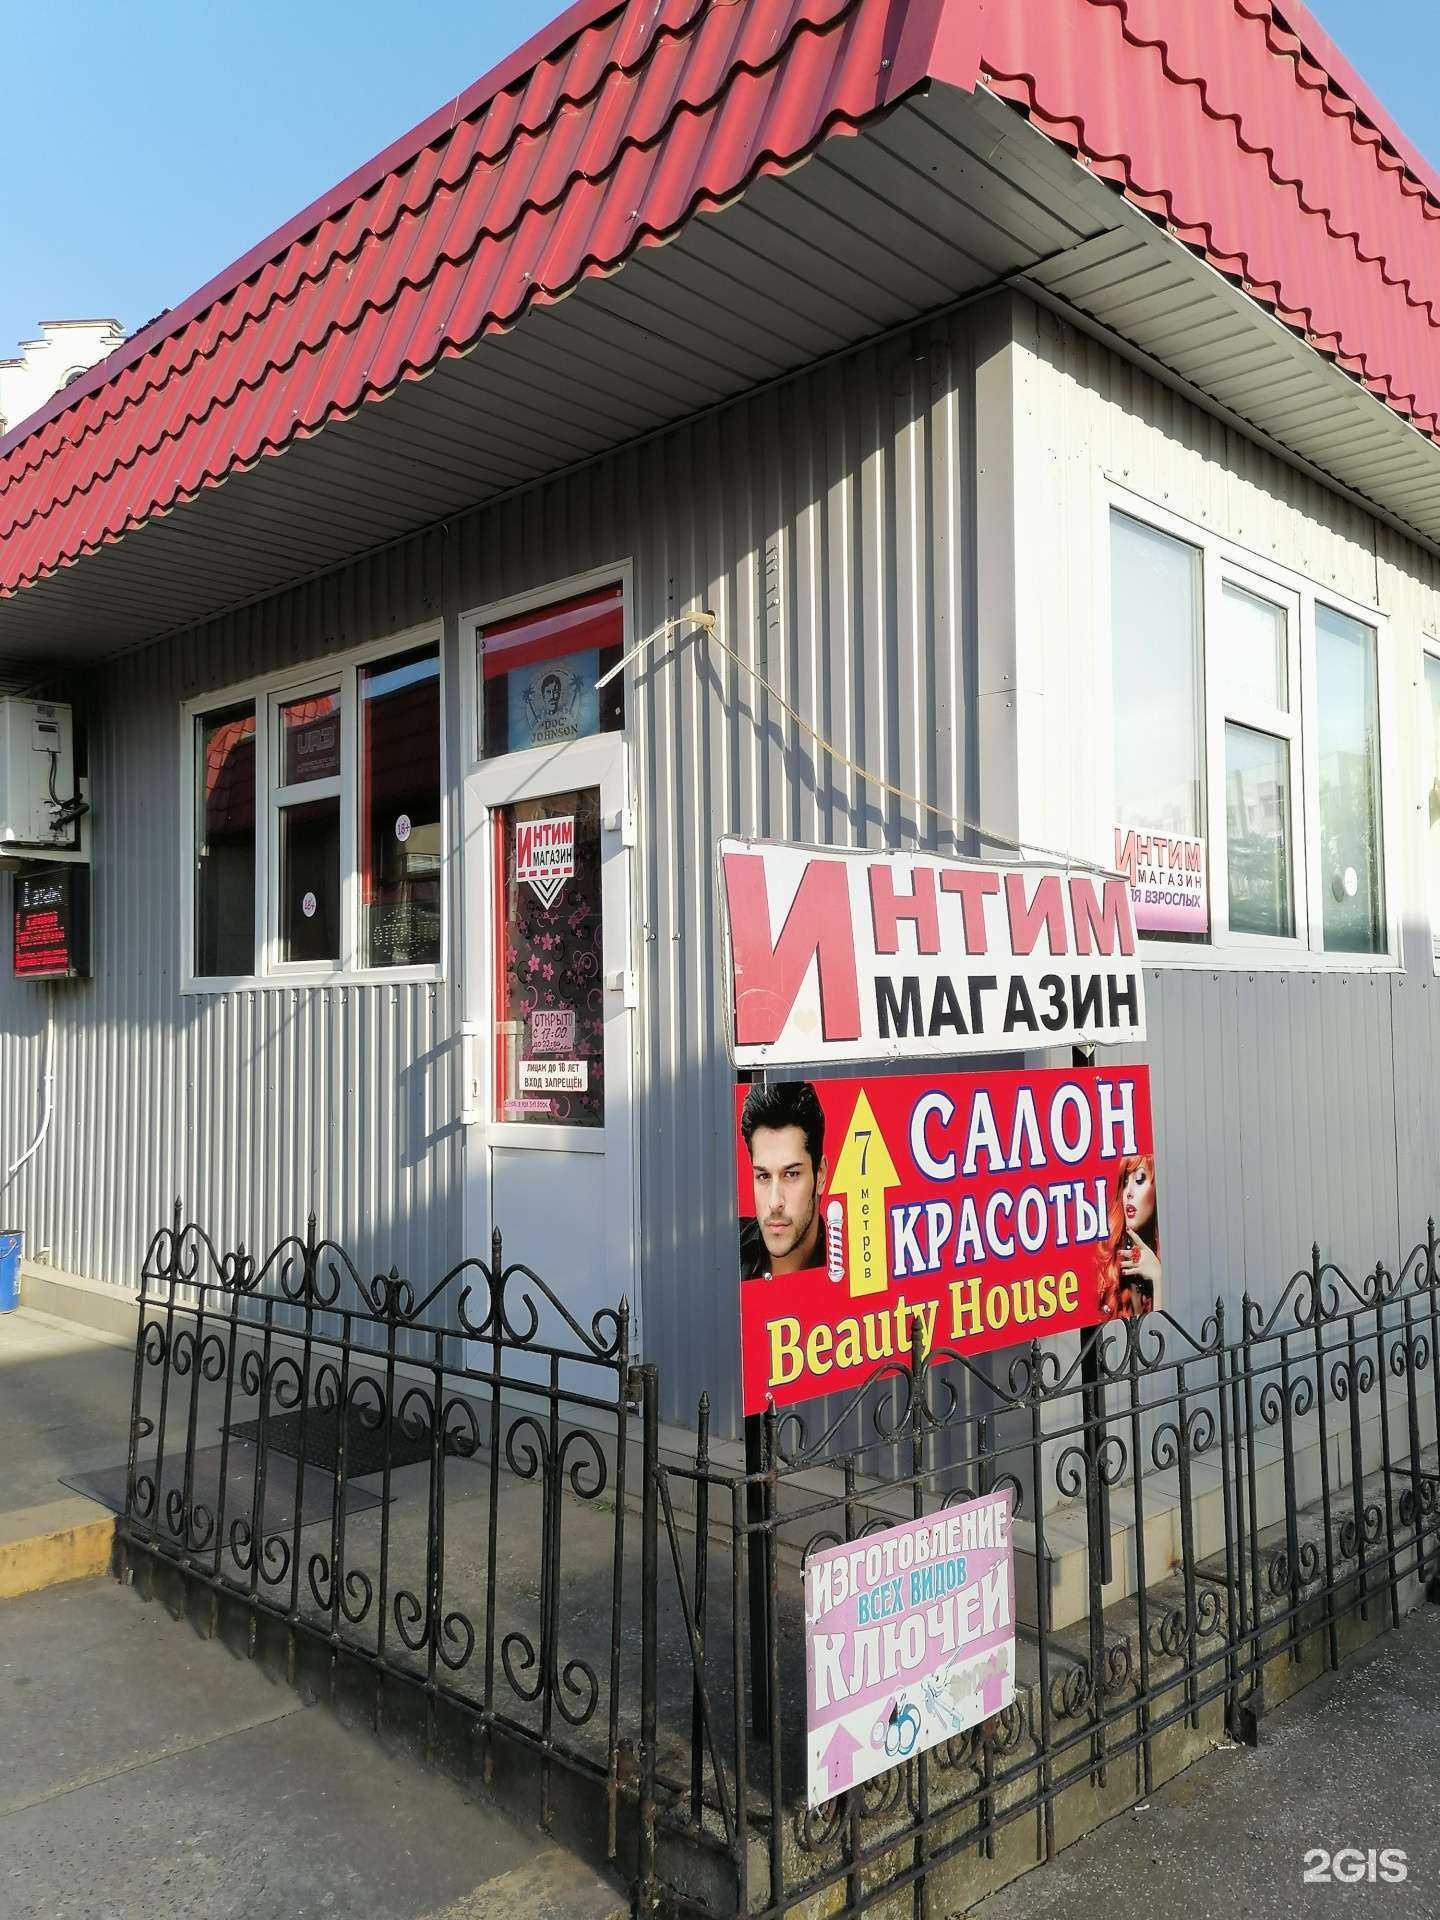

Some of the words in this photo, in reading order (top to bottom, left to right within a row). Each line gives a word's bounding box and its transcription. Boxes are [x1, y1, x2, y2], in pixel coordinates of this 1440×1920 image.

[530, 723, 578, 742] JOHNSON
[398, 822, 410, 836] 18+
[518, 821, 573, 868] ИНТИМ
[533, 848, 572, 867] МАГАЗИН
[1114, 828, 1201, 887] ИНТИМ
[1138, 870, 1201, 888] МАГАЗИН
[1145, 889, 1201, 908] ВЗРОСЛЫХ
[723, 852, 1136, 1046] ИНТИМ
[874, 973, 1139, 1039] МАГАЗИН
[524, 1077, 543, 1088] ВХОД
[559, 1062, 566, 1072] 18
[568, 1063, 580, 1072] ЛЕТ
[854, 1129, 872, 1176] 7
[909, 1080, 1138, 1182] САЛОН
[860, 1187, 872, 1279] метров
[890, 1178, 1111, 1277] КРАСОТЫ
[766, 1295, 939, 1388] Beauty
[949, 1269, 1079, 1341] House
[811, 1500, 1008, 1618] ИЗГОТОВЛЕНИЕ
[857, 1575, 905, 1625] ВСЕХ
[910, 1556, 968, 1608] ВИДОВ
[813, 1557, 1011, 1711] КЛЮЧЕЙ
